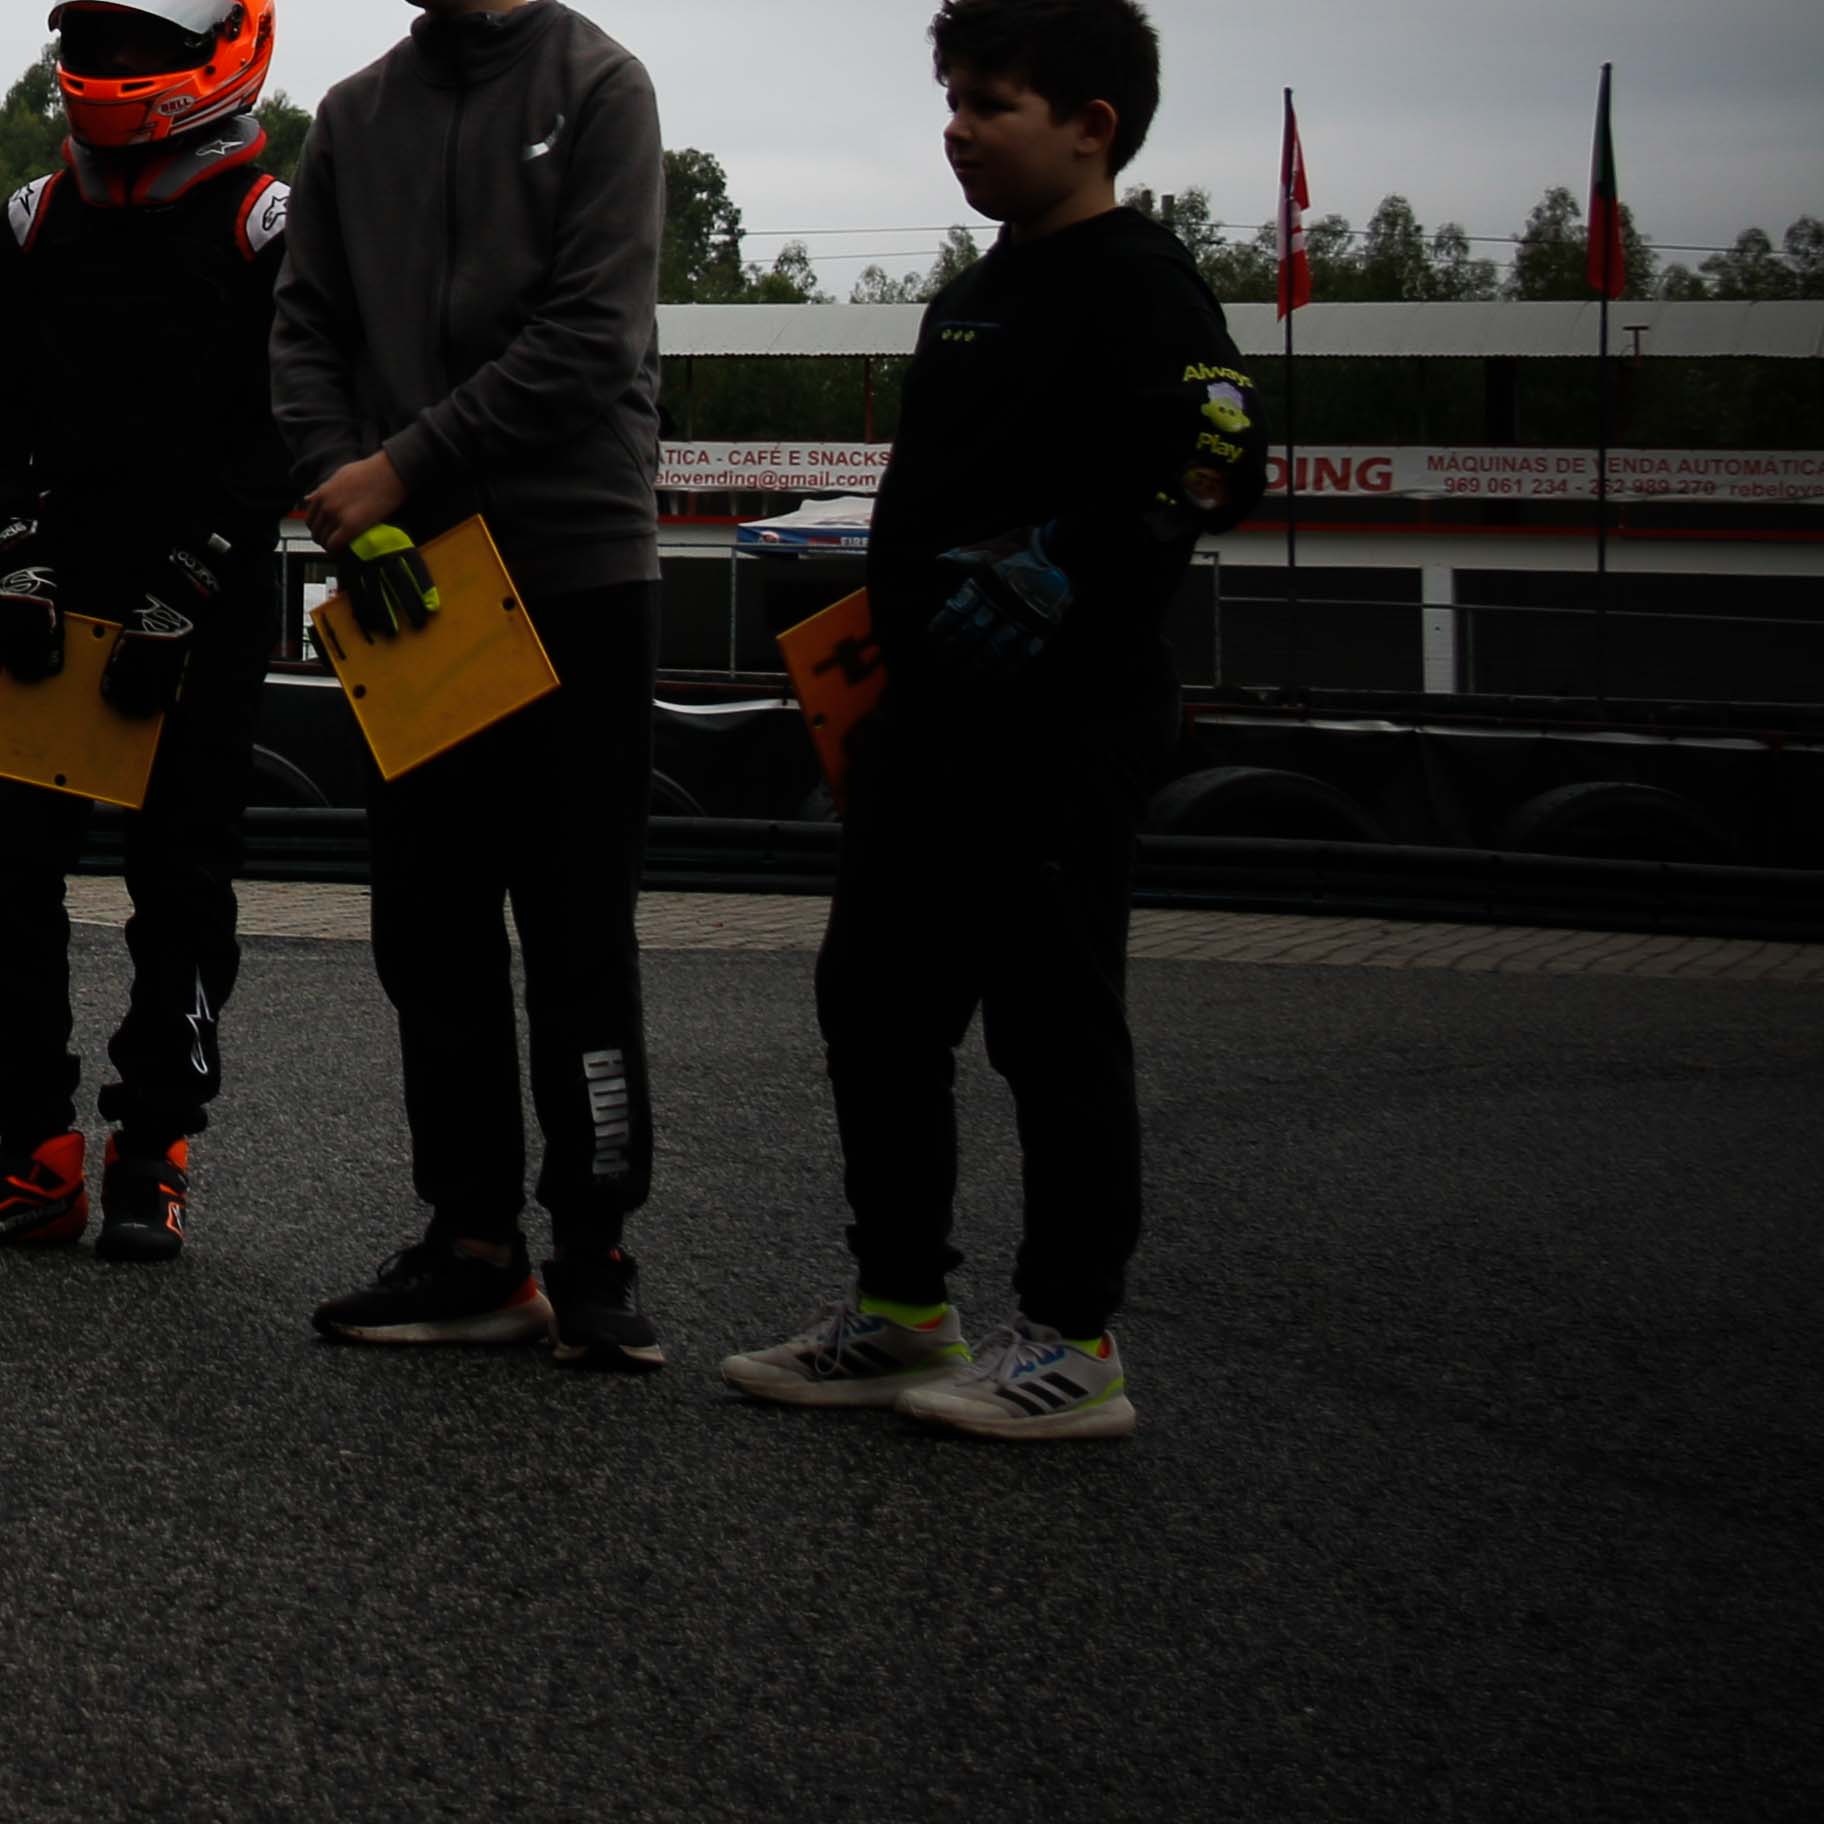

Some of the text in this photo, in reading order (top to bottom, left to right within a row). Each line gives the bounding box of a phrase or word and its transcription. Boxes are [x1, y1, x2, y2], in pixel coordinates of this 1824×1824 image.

[161, 98, 191, 113] BELL
[728, 444, 782, 466] CAFÉ
[789, 449, 801, 466] E
[807, 450, 893, 467] SNACKS
[1195, 430, 1247, 464] Play
[1427, 452, 1548, 474] MÁQUINAS
[1556, 457, 1586, 474] DE
[1444, 478, 1481, 494] 969
[1488, 478, 1523, 494] 061
[1532, 478, 1568, 494] 234
[582, 1048, 632, 1176] PUMA
